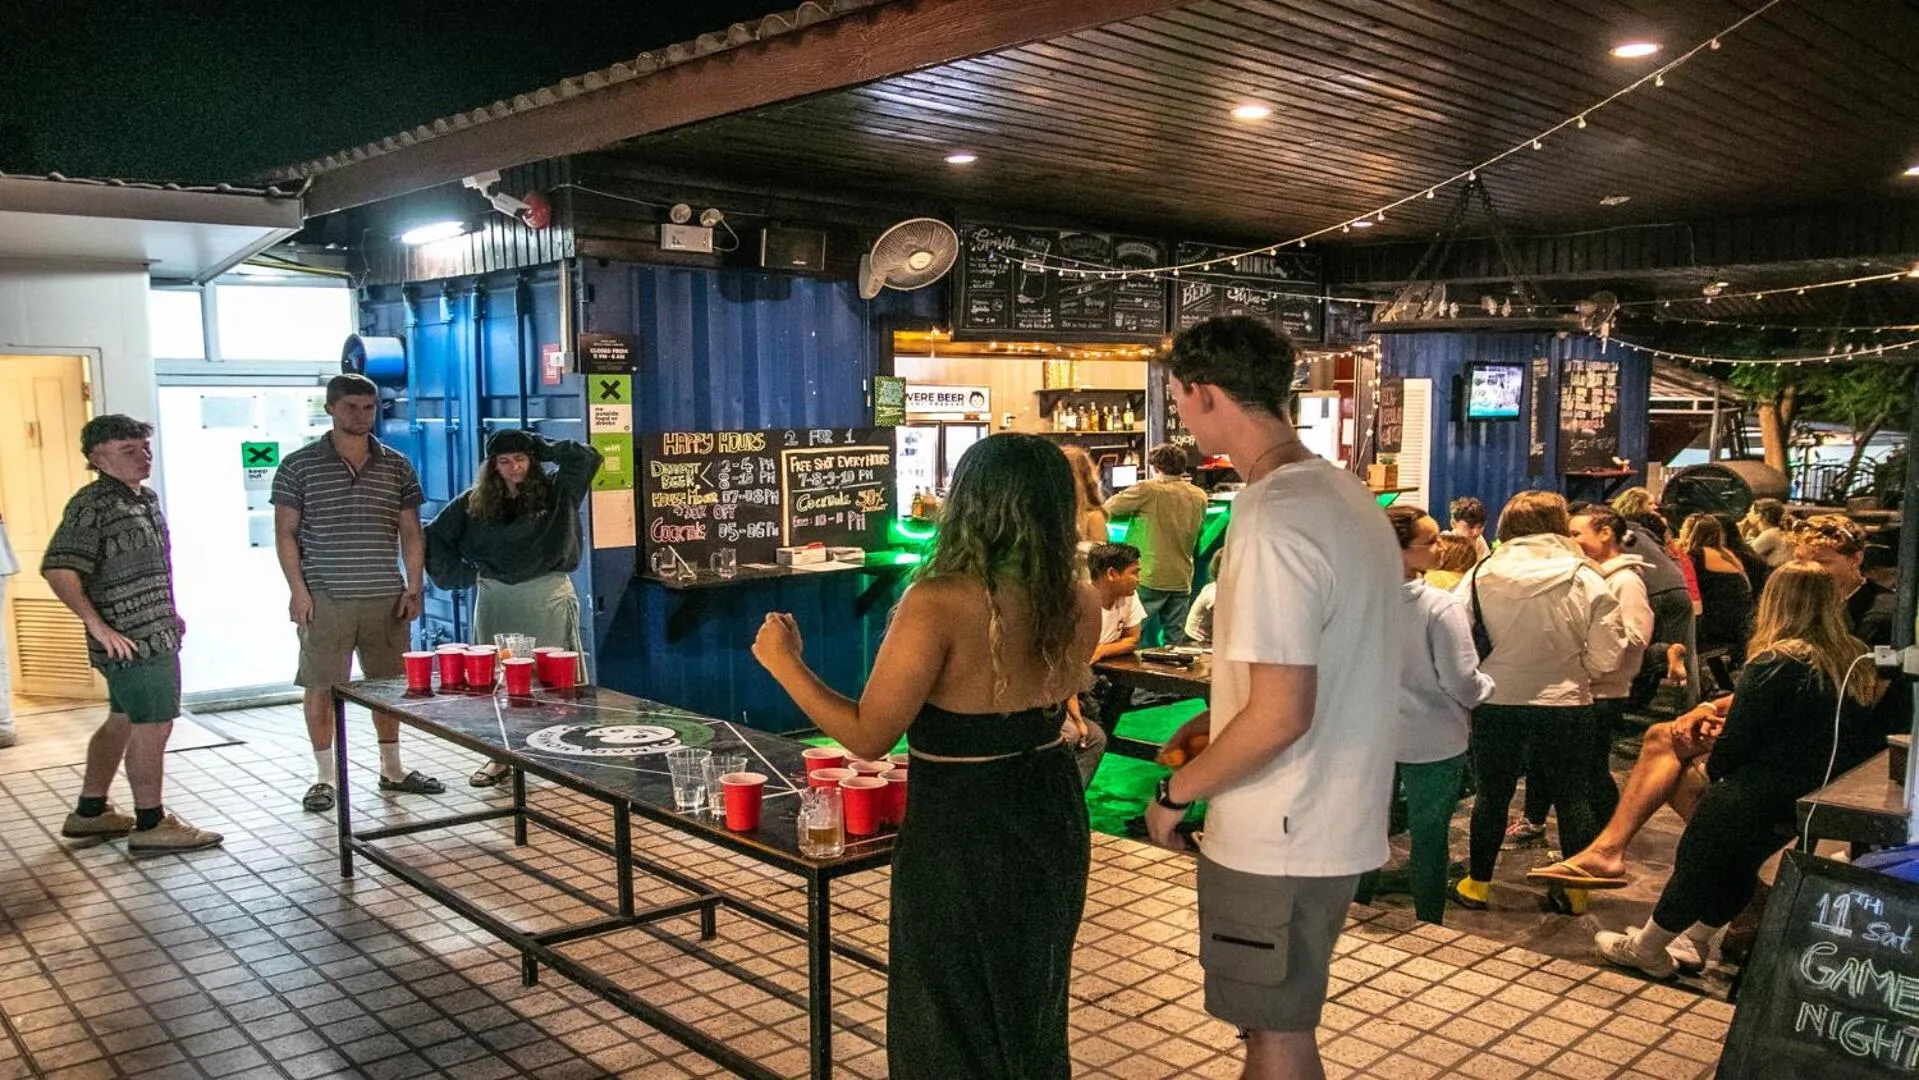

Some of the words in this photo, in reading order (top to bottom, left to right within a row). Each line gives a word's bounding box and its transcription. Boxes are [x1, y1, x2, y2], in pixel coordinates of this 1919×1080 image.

[1182, 283, 1212, 306] BEER
[937, 393, 964, 402] BEER
[663, 432, 713, 455] HAPPY
[718, 431, 766, 453] HOURS
[784, 429, 799, 446] 2
[809, 429, 834, 446] FOR
[844, 428, 856, 444] 1
[790, 456, 812, 472] FREE
[814, 456, 835, 470] SHOT
[837, 455, 866, 468] EVERY
[661, 474, 695, 489] BEER
[759, 471, 776, 484] PM
[859, 469, 873, 481] PM
[713, 504, 738, 519] OFF
[847, 510, 866, 531] PM
[1800, 941, 1919, 1018] GAME
[1795, 1001, 1919, 1071] NIGHT
